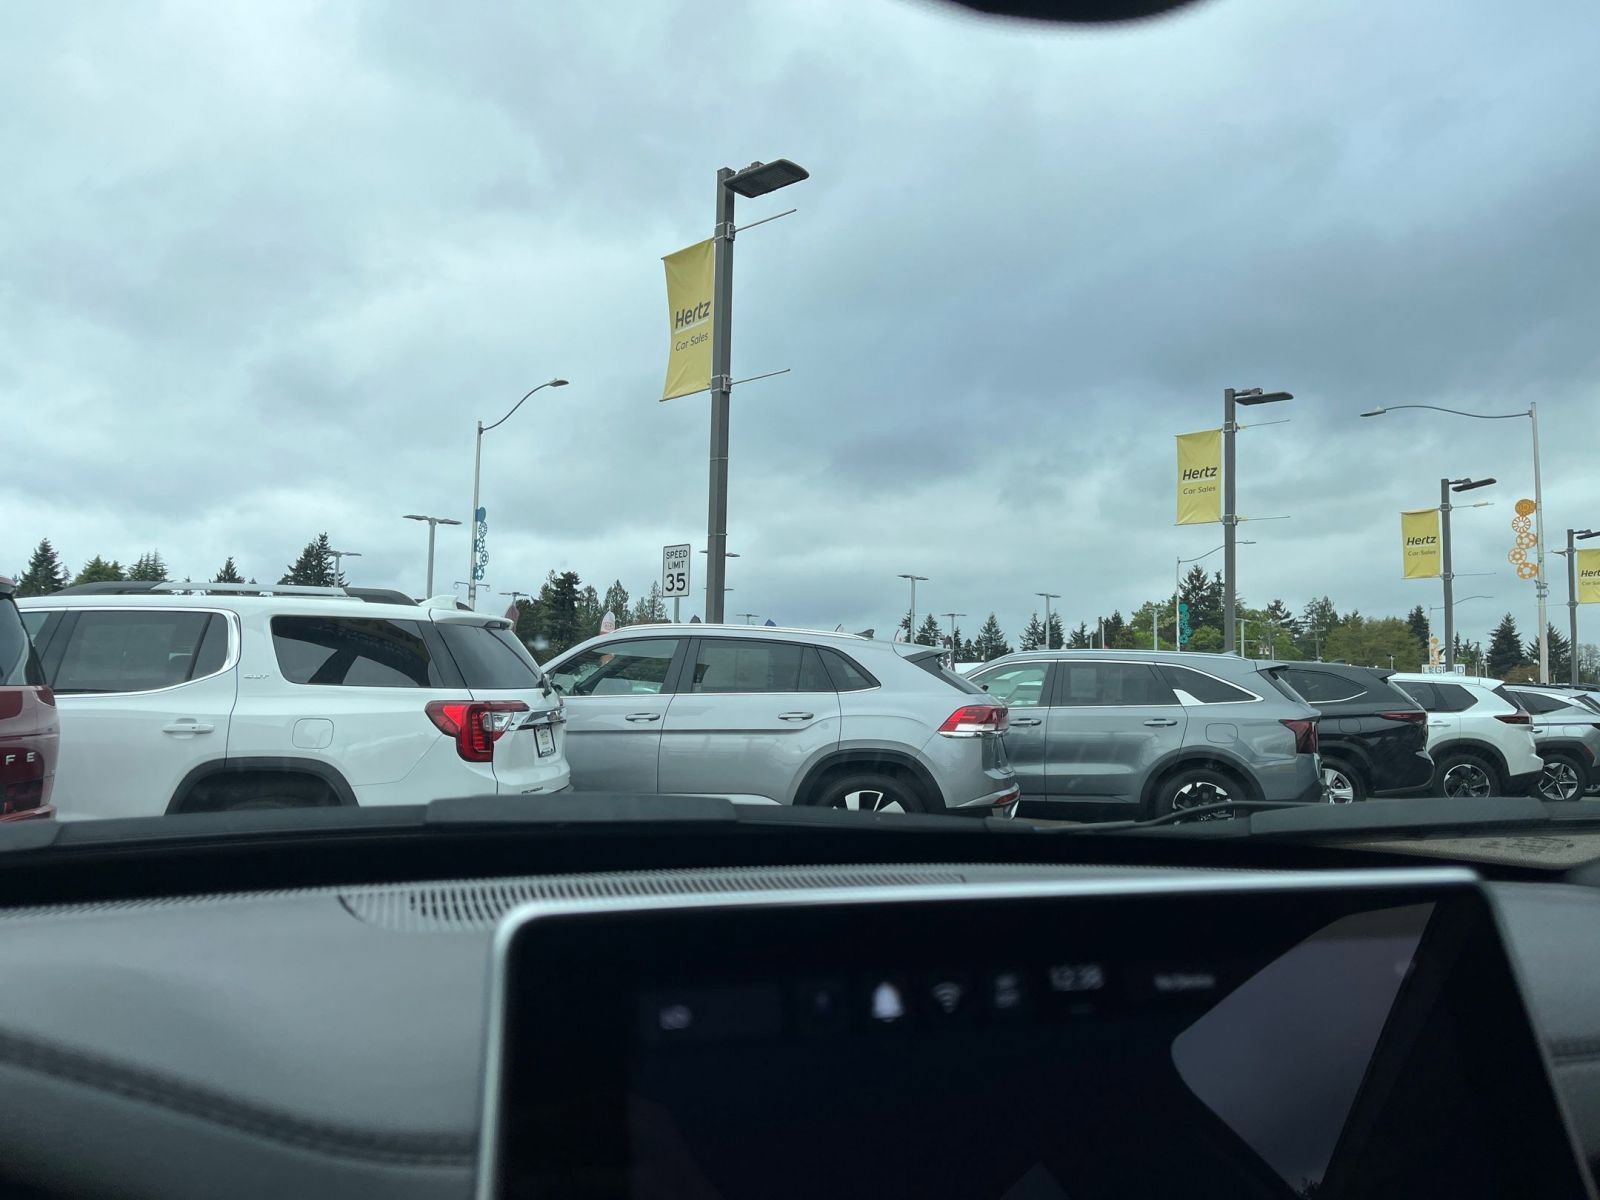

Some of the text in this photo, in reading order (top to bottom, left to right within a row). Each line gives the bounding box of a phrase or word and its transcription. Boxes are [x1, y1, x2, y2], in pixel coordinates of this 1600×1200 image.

[675, 301, 711, 329] Hertz
[675, 332, 709, 352] Car Sales
[1183, 466, 1217, 480] Hertz
[1407, 536, 1437, 546] Hertz
[666, 550, 687, 559] SPEED
[668, 561, 684, 569] LIMIT
[665, 573, 686, 592] 35
[1423, 665, 1465, 674] LEGD
